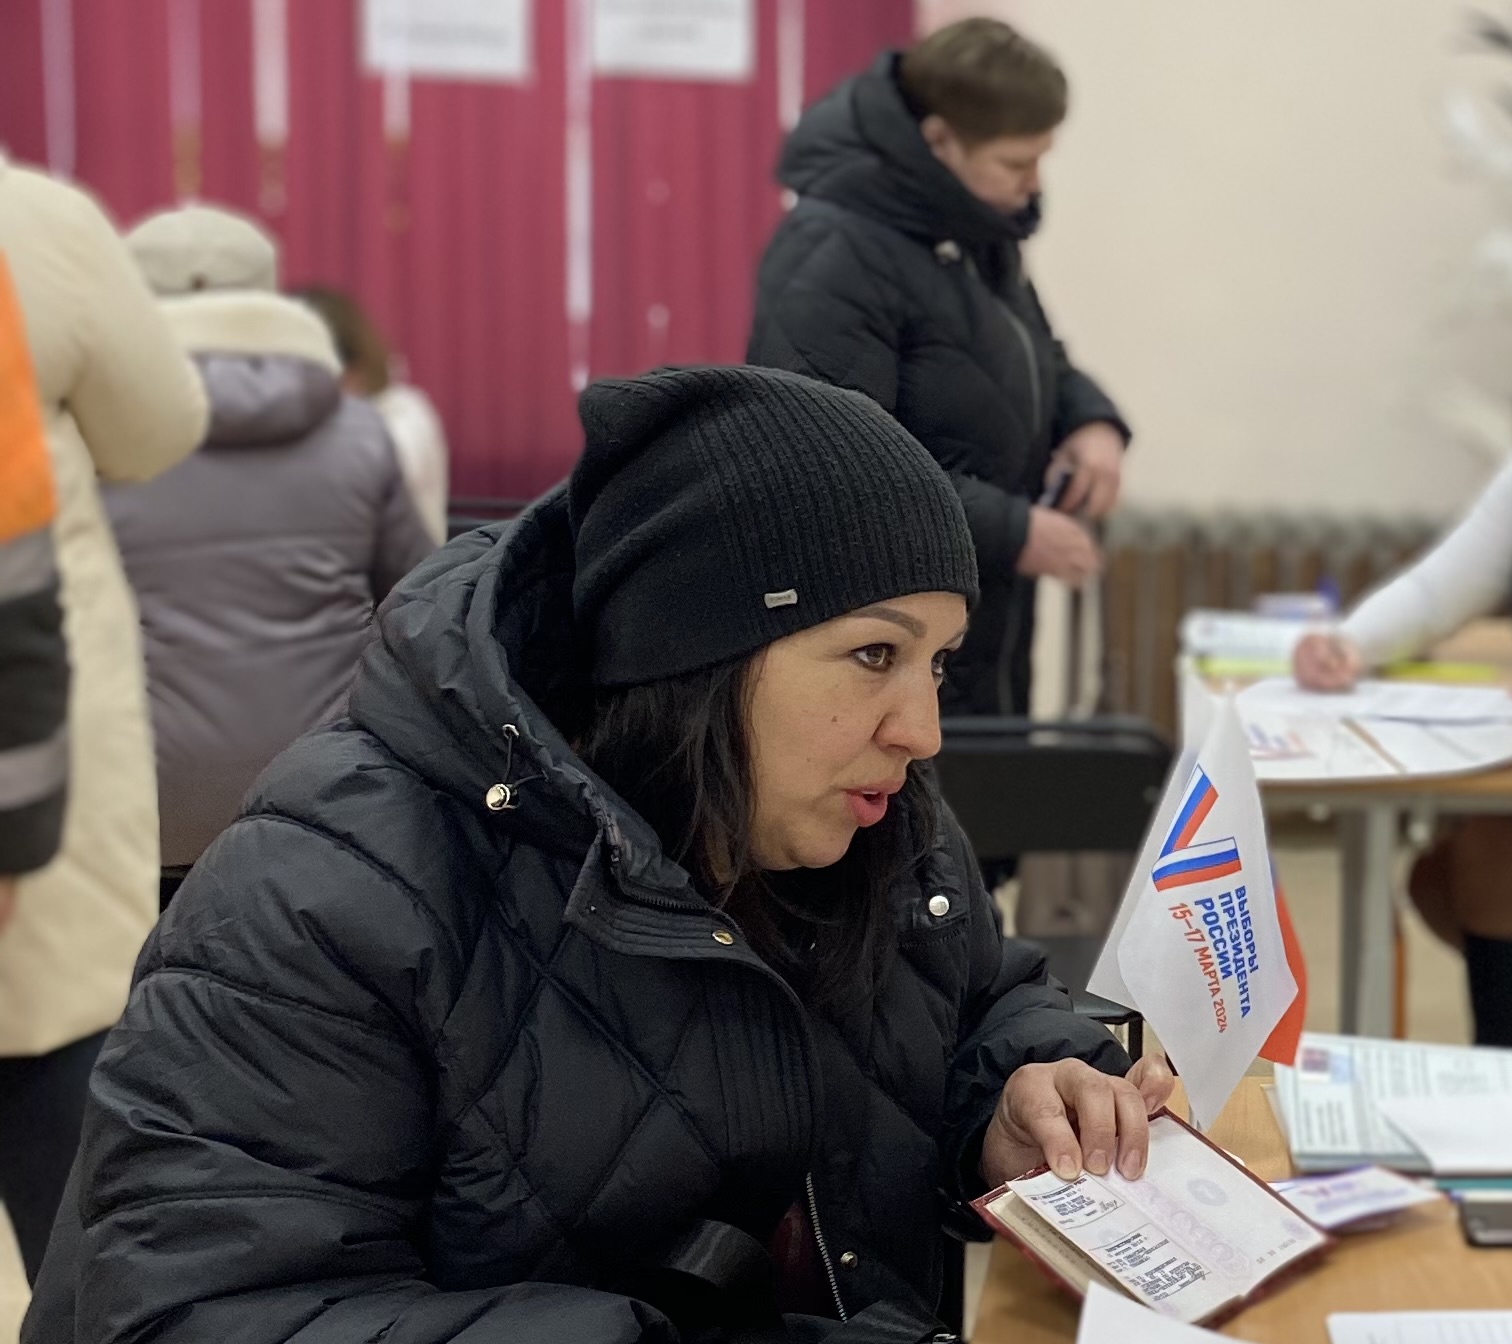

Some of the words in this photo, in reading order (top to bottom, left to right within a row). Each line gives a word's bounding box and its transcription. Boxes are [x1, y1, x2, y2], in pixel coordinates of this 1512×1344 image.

[1194, 897, 1232, 980] РОССИИ
[1218, 891, 1251, 1018] ПРЕЗИДЕНТА
[1235, 885, 1259, 973] ВЫБОРЫ
[1194, 946, 1221, 998] МАРТА
[1213, 998, 1228, 1034] 2024
